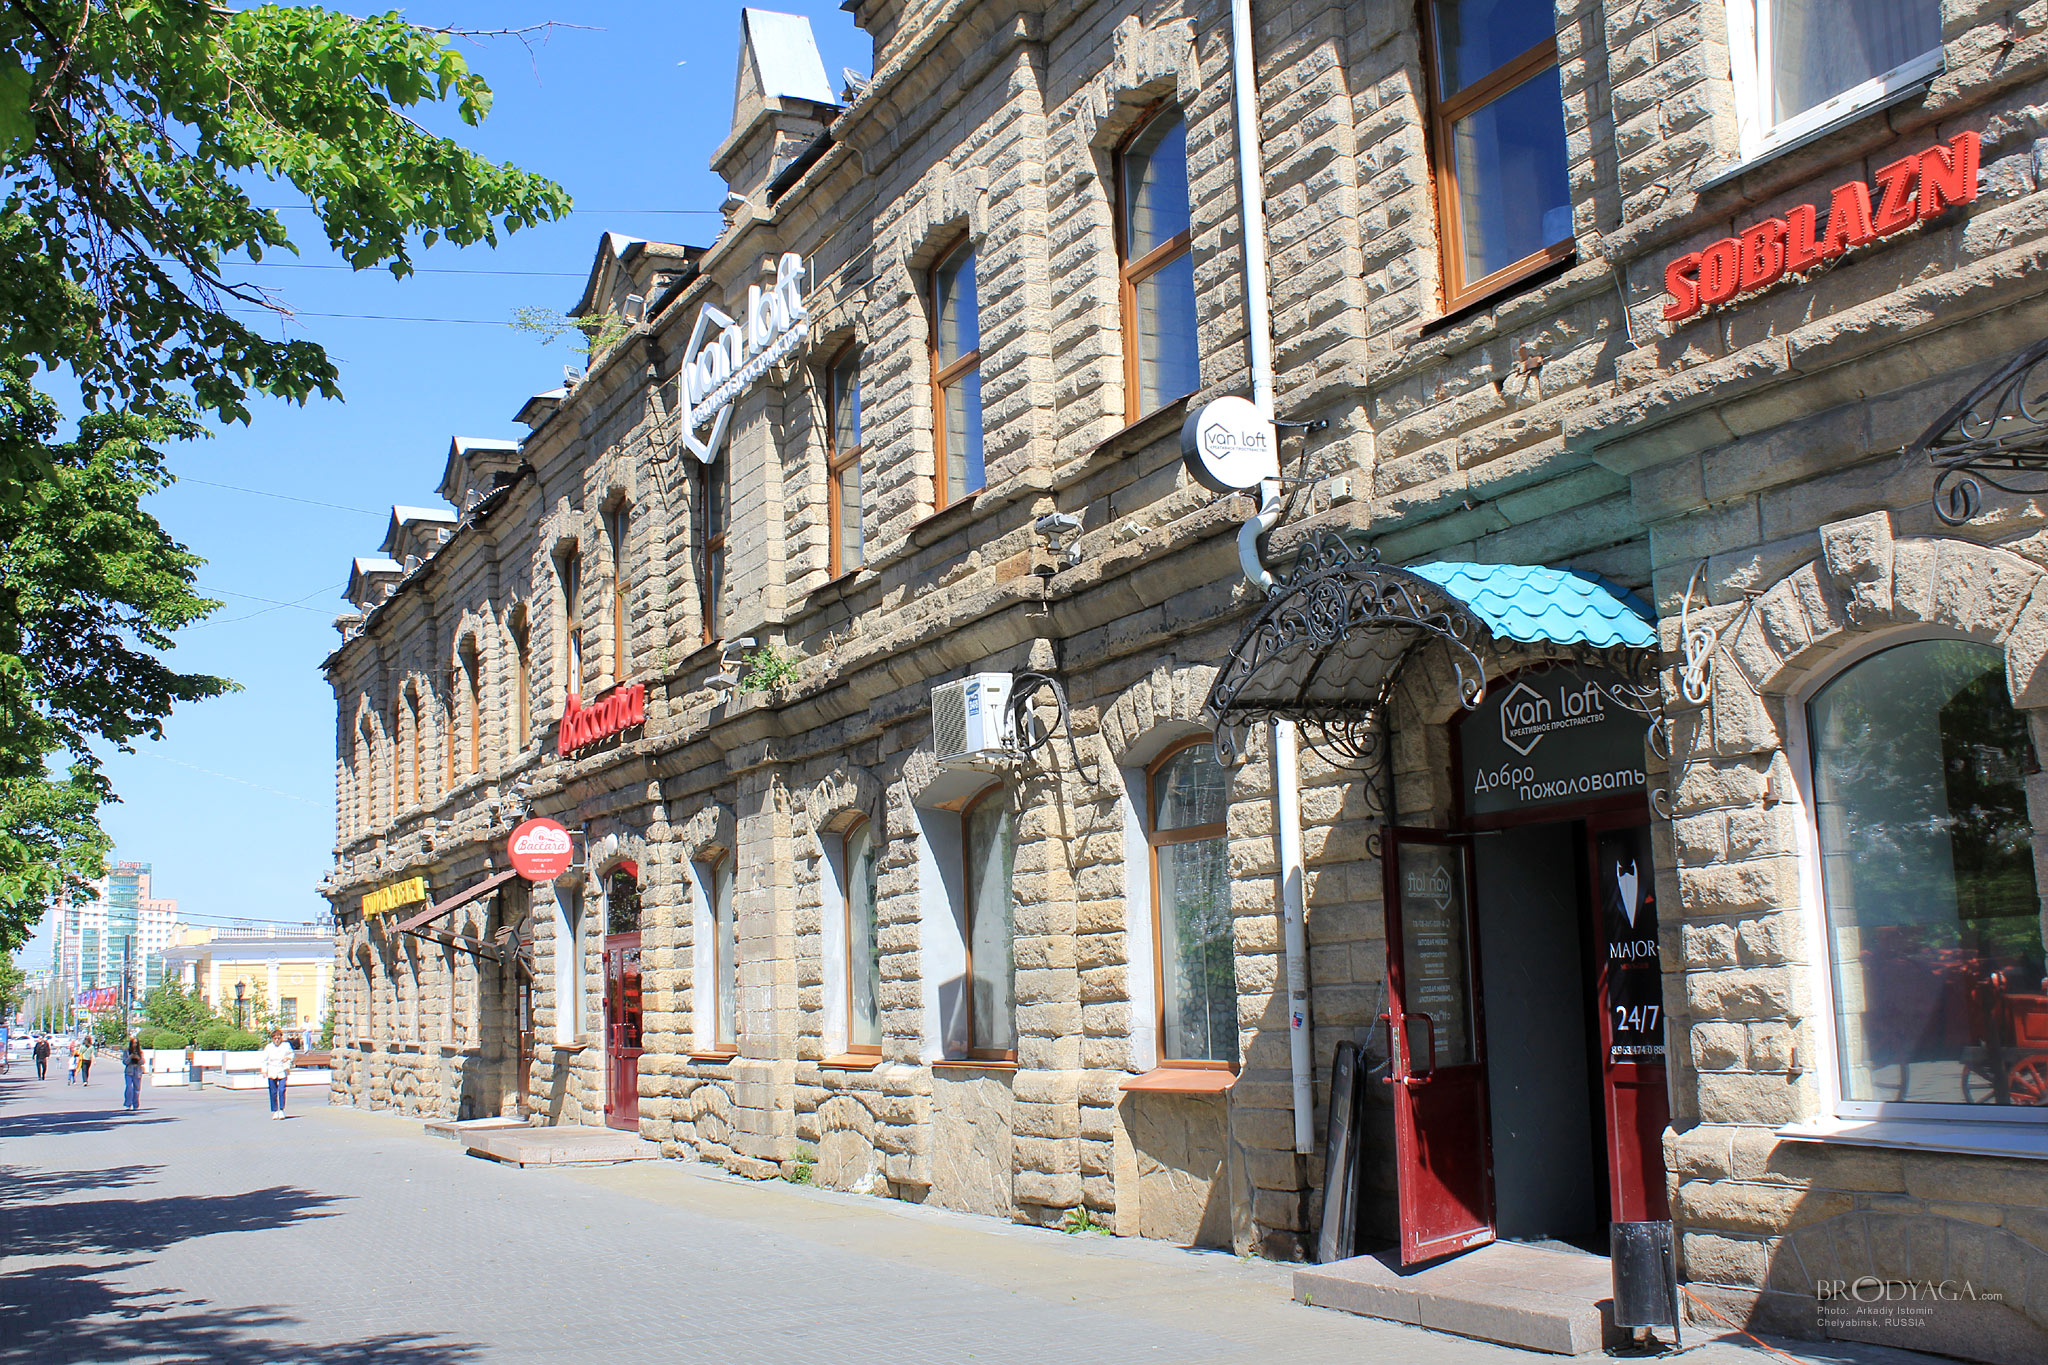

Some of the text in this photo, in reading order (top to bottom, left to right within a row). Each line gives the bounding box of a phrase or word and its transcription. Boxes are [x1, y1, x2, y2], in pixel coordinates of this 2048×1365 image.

[1663, 130, 1981, 322] SOBLAZN
[687, 252, 807, 404] van loft
[1208, 431, 1267, 447] van loft
[1505, 681, 1604, 727] van loft
[558, 683, 645, 757] Baccara
[1510, 713, 1605, 737] КРЕАТИВНОЕ ПРОСТРАНСТВО
[1474, 763, 1535, 794] Добро
[1520, 768, 1646, 801] пожаловать
[518, 840, 566, 850] Baccara
[1610, 940, 1656, 961] MAJOR
[1616, 1005, 1660, 1034] 24/7
